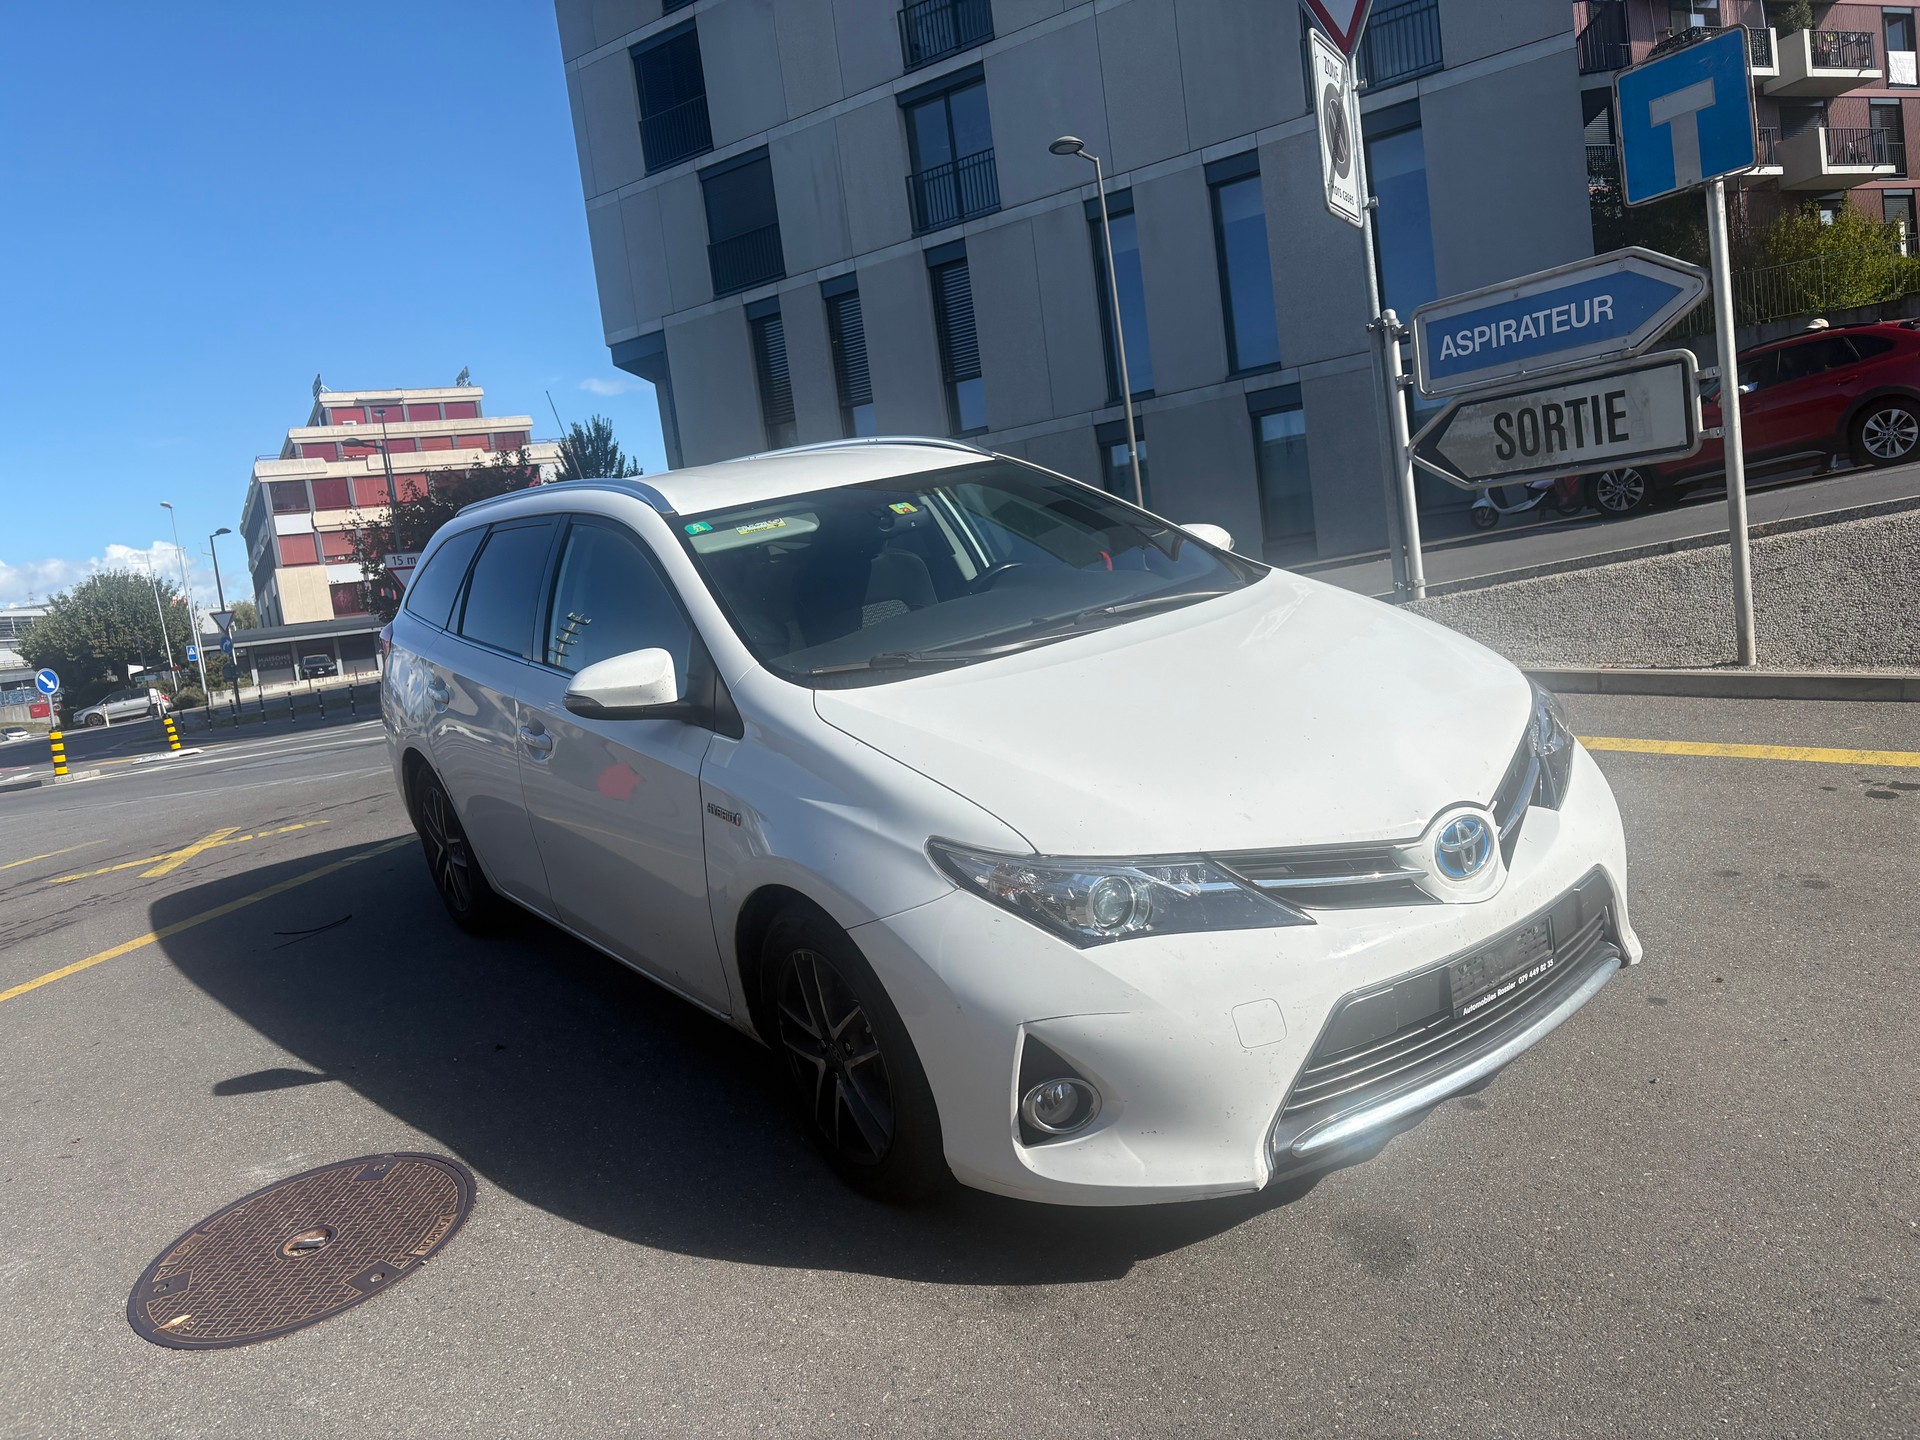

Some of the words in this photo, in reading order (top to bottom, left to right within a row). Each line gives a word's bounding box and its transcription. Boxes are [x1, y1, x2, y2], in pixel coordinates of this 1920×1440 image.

[1323, 55, 1339, 83] ZONE
[1440, 294, 1614, 361] ASPIRATEUR
[1493, 390, 1630, 461] SORTIE
[392, 555, 404, 566] 15
[406, 556, 417, 565] m
[1463, 992, 1497, 1016] Automobiles
[1497, 981, 1516, 997] Rossier
[1518, 973, 1529, 985] 079
[1529, 966, 1540, 978] 449
[1547, 958, 1554, 968] 35
